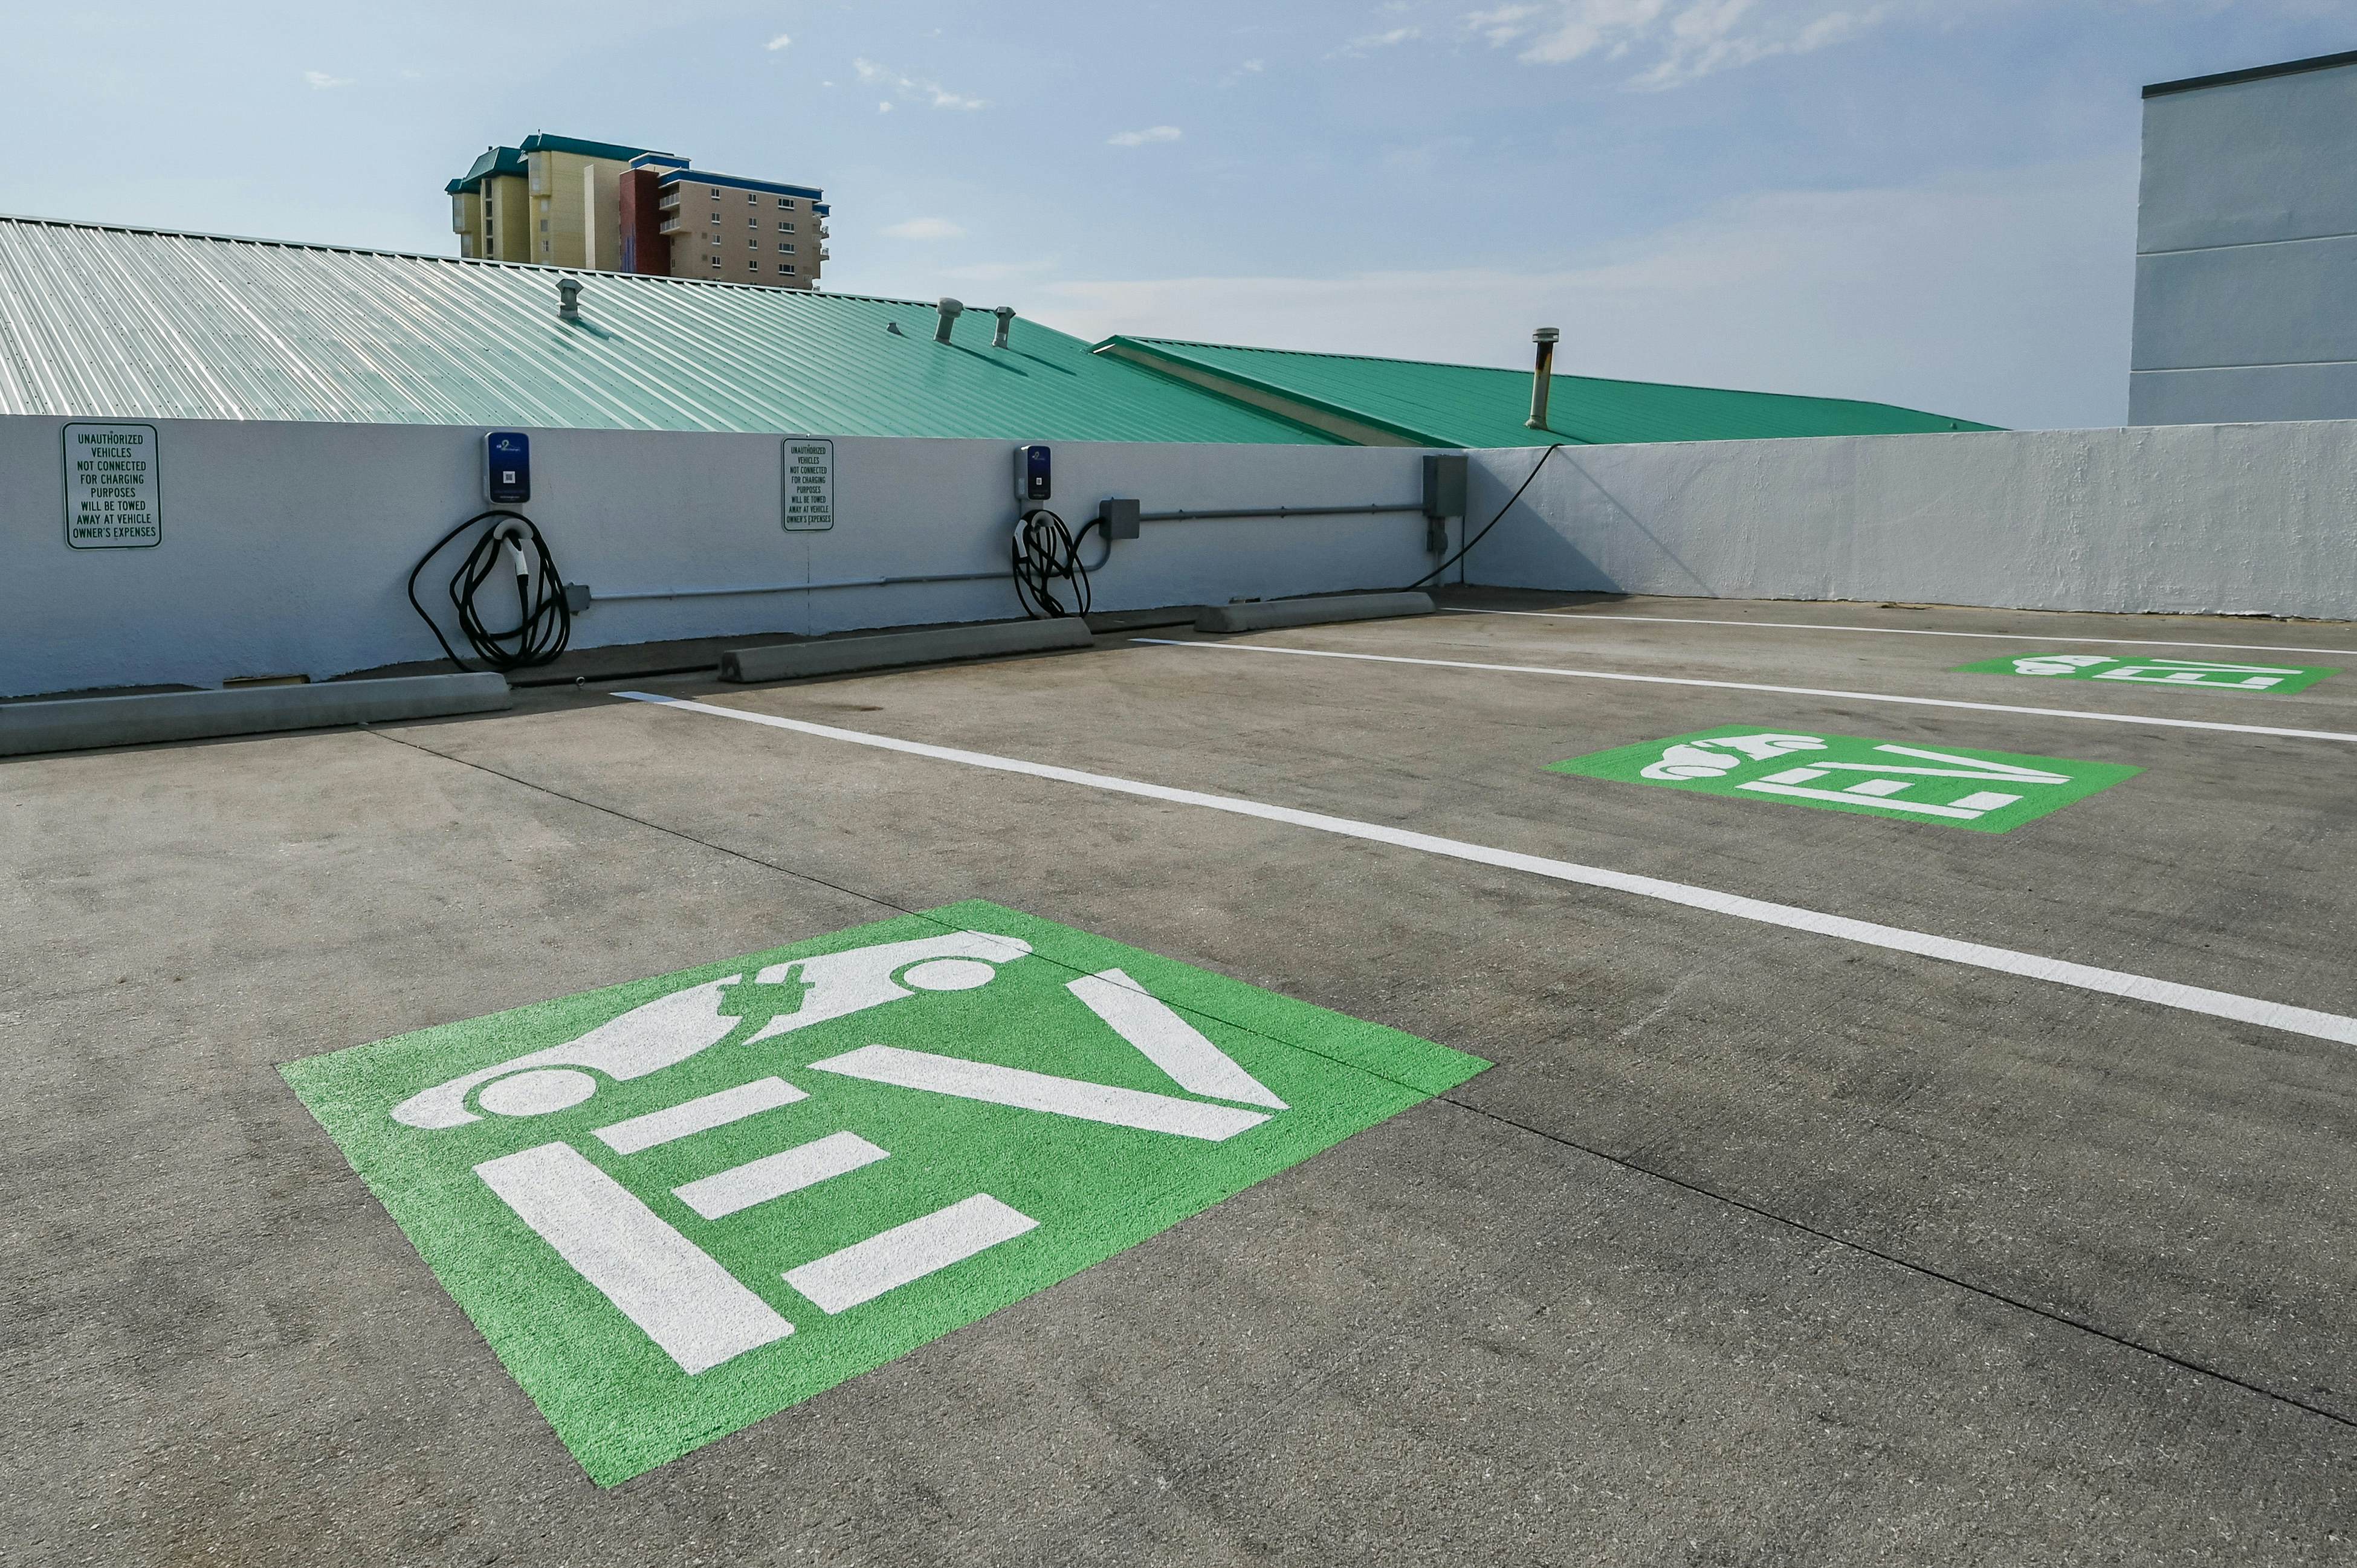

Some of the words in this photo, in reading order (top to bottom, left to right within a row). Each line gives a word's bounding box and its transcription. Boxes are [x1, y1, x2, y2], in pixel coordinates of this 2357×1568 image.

[78, 434, 143, 444] UNAUTHORIZED
[91, 448, 132, 457] VEHICLES
[77, 461, 93, 471] NOT
[97, 461, 146, 471] CONNECTED
[80, 474, 97, 484] FOR
[101, 474, 144, 484] CHARGING
[91, 488, 135, 497] PURPOSES
[81, 501, 102, 511] WILL
[105, 501, 115, 511] BE
[118, 501, 146, 511] TOWED
[77, 515, 100, 524] AWAY
[104, 515, 114, 524] AT
[117, 514, 151, 524] VEHICLE
[73, 528, 111, 538] OWNER'S
[114, 527, 156, 537] EXPENSES
[2092, 659, 2303, 689] EV
[1735, 744, 2074, 819] EV
[471, 968, 1290, 1375] EV
